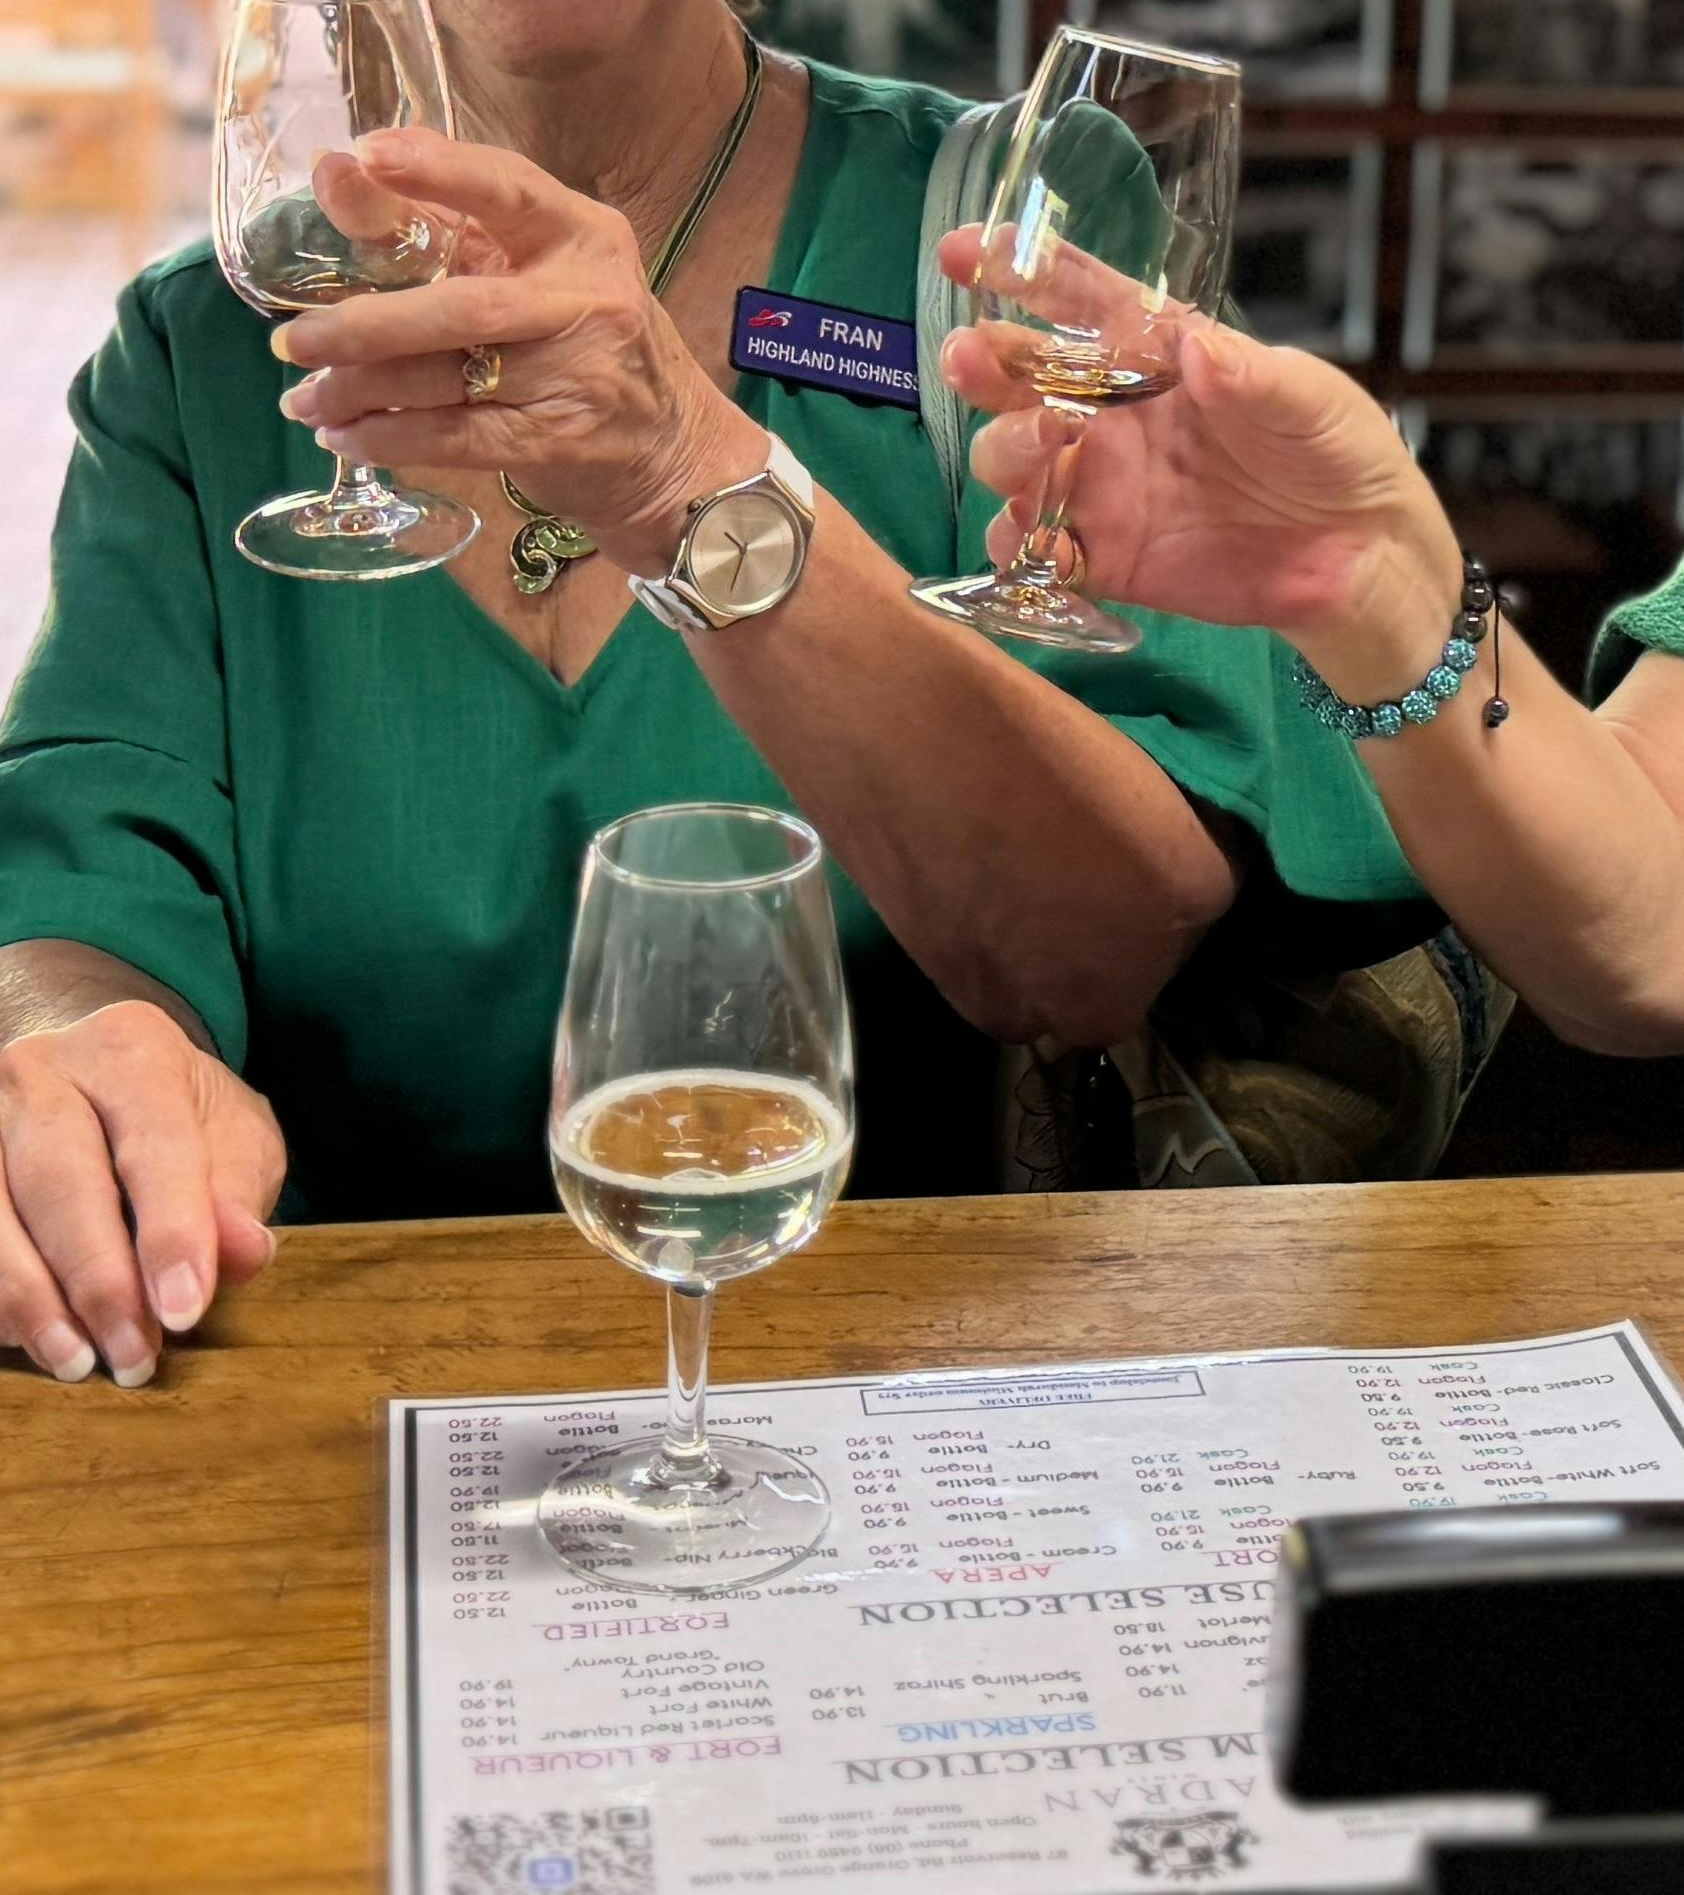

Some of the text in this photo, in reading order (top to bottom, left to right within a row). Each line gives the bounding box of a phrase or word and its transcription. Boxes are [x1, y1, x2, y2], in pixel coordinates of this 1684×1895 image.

[818, 317, 884, 351] FRAN
[747, 336, 836, 372] HIGHLAND
[1428, 1361, 1479, 1372] Cask
[1356, 1375, 1486, 1388] Flagon 12.90
[1543, 1374, 1615, 1392] Classic
[1433, 1389, 1492, 1400] Bottle
[1451, 1403, 1500, 1414] Cask
[543, 1410, 615, 1423] Flagon
[558, 1424, 619, 1437] Bottle
[1373, 1417, 1509, 1431] Flagon 12.90
[1581, 1419, 1621, 1432] Soft
[846, 1430, 984, 1448] Flagon 15.90
[1458, 1431, 1516, 1443] Bottle
[847, 1450, 890, 1462] 9.90
[928, 1443, 988, 1455] Bottle
[1472, 1446, 1524, 1458] Cask
[1131, 1448, 1249, 1465] Cask 21.90
[920, 1463, 993, 1475] Flagon
[1208, 1460, 1281, 1472] Flagon
[1394, 1460, 1533, 1477] Flagon 12.90
[1619, 1460, 1661, 1476] Soft
[854, 1470, 1099, 1495] Medium Bottle 9.90
[1140, 1482, 1183, 1494] 9.90
[1213, 1475, 1274, 1488] Bottle
[1483, 1475, 1544, 1487] Bottle
[930, 1496, 1003, 1509] Flagon
[864, 1504, 1090, 1529] Sweet Bottle 9.90
[1150, 1504, 1272, 1523] Cask 21.90
[938, 1536, 1013, 1550] Flagon
[1160, 1540, 1204, 1552] 9.90
[958, 1551, 1021, 1564] Bottle
[1041, 1544, 1116, 1558] Cream
[1214, 1549, 1279, 1567] ORT
[934, 1564, 1051, 1584] APERA
[767, 1583, 838, 1597] Green
[571, 1598, 637, 1611] Bottle
[859, 1587, 1164, 1626] SELECTION
[453, 1607, 506, 1620] 12.50
[542, 1612, 729, 1641] FORTIFIED
[1197, 1615, 1271, 1629] Merlot
[1119, 1642, 1172, 1656] 14.90
[459, 1659, 765, 1693] Old Country 19.90
[1125, 1663, 1179, 1677] 14.90
[809, 1670, 1082, 1700] Sparkling Shiraz 14.90
[1138, 1684, 1186, 1698] 11.90
[460, 1678, 770, 1711] Vintage Fort 14.90
[460, 1697, 772, 1729] White Fort 14.90
[811, 1691, 1089, 1721] Brut 13.90
[461, 1714, 775, 1748] Scarlet Red Liqueur 14.90
[897, 1713, 1096, 1743] SPARKLING
[473, 1737, 781, 1775] FORT & LIQUEUR
[844, 1739, 1186, 1784] SELECTION
[1044, 1776, 1256, 1812] ADRAN
[892, 1803, 963, 1819] Sunday
[926, 1819, 981, 1833] hours
[986, 1815, 1036, 1829] Open
[908, 1837, 969, 1852] Phone
[779, 1865, 835, 1879] Grove
[841, 1859, 909, 1875] Orange
[740, 1869, 773, 1883] WA
